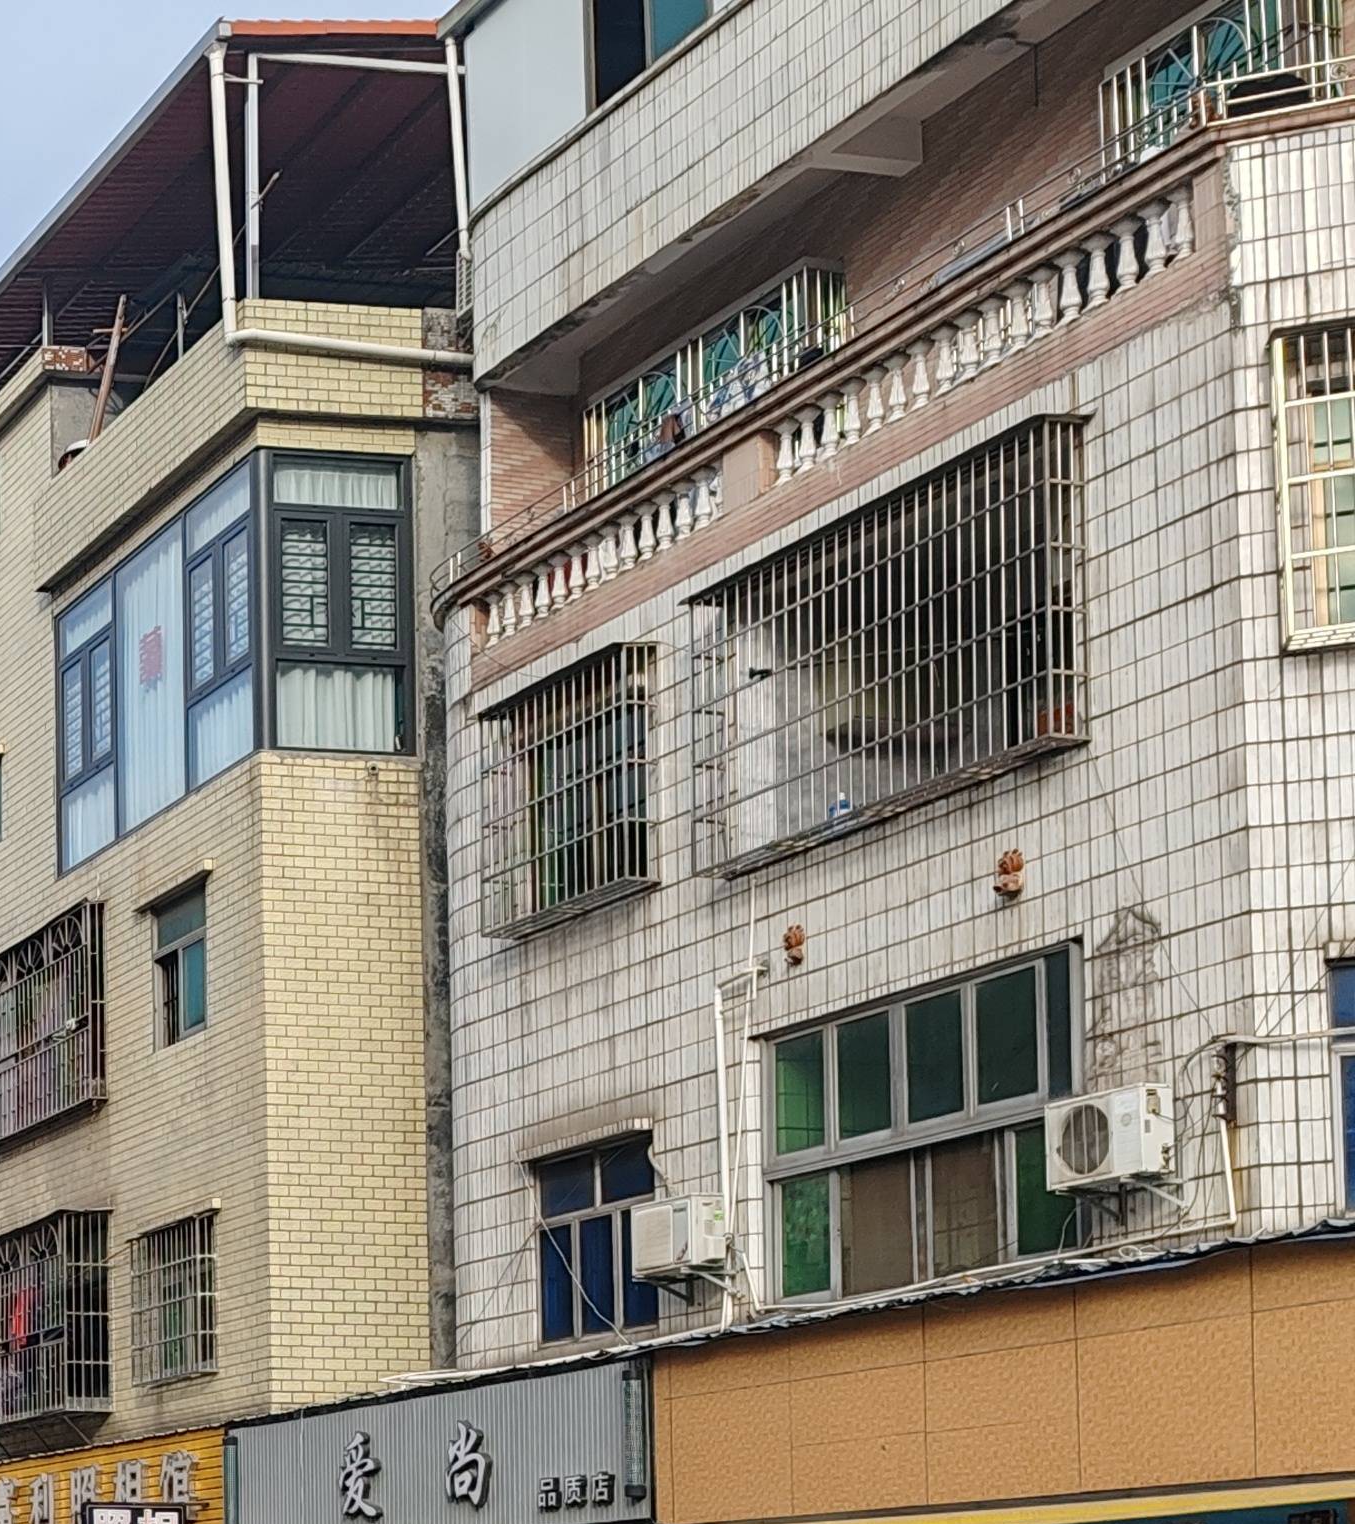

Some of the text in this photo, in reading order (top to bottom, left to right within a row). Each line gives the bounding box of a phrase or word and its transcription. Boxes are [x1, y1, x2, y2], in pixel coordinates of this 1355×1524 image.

[339, 1420, 615, 1520] 爱尚 品质店
